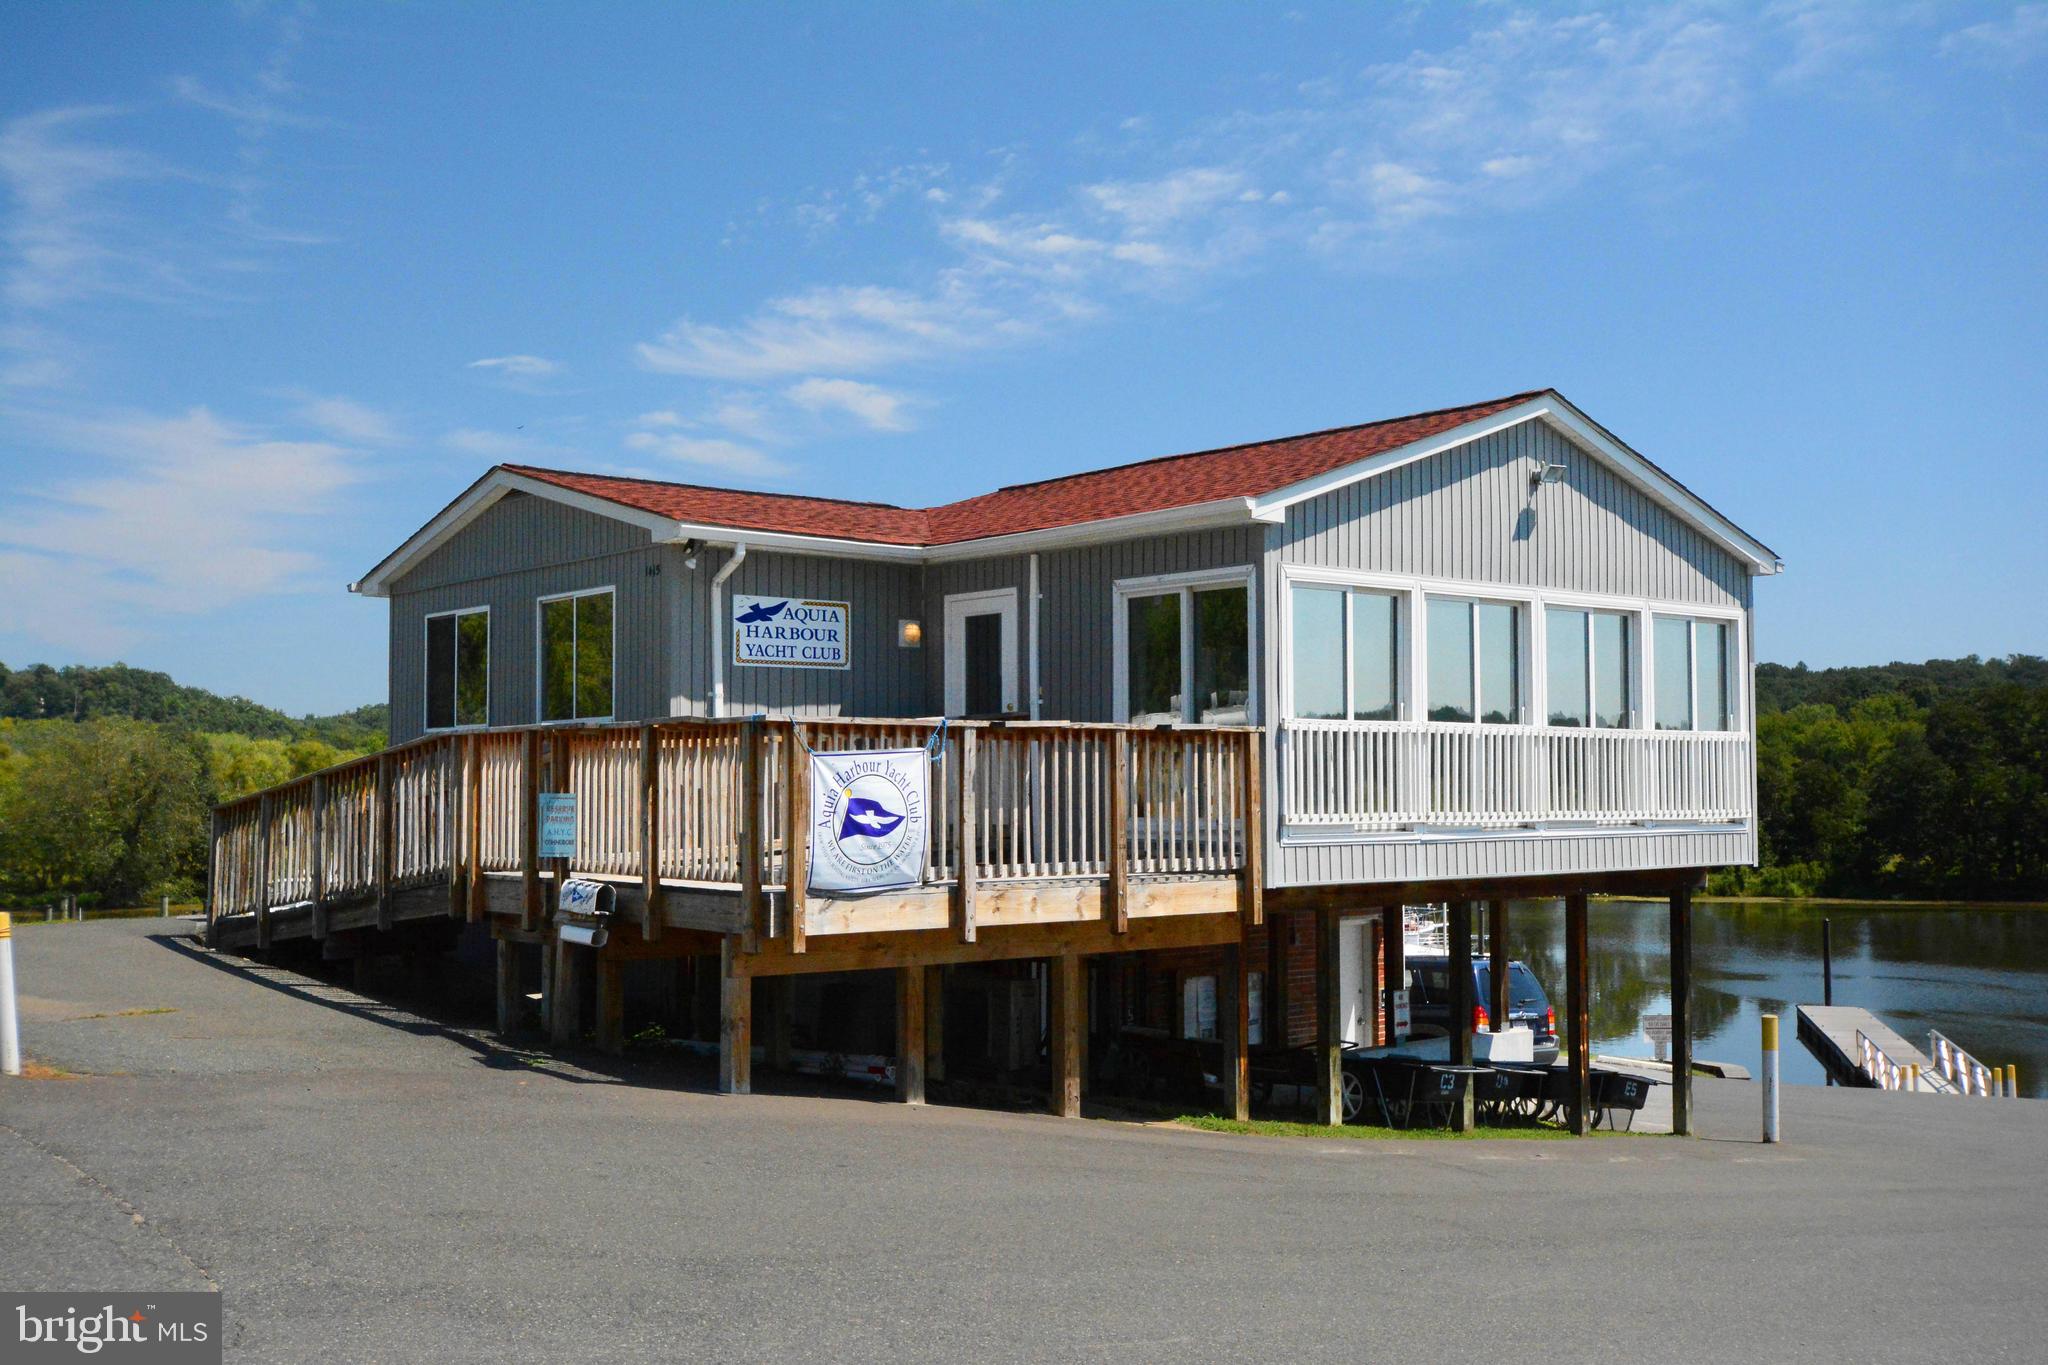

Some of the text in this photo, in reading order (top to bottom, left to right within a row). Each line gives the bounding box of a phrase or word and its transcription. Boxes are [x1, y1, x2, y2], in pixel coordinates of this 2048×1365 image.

[784, 608, 840, 625] AQUIA
[746, 625, 840, 642] HARBOUR
[746, 644, 840, 660] YACHT CLUB
[818, 760, 923, 828] Aquia Harbour Yacht Club
[833, 853, 846, 868] ARE
[845, 864, 866, 876] FIRST
[866, 866, 878, 875] ON
[878, 859, 895, 872] THE
[894, 834, 913, 861] WATER
[1440, 1074, 1455, 1090] C3
